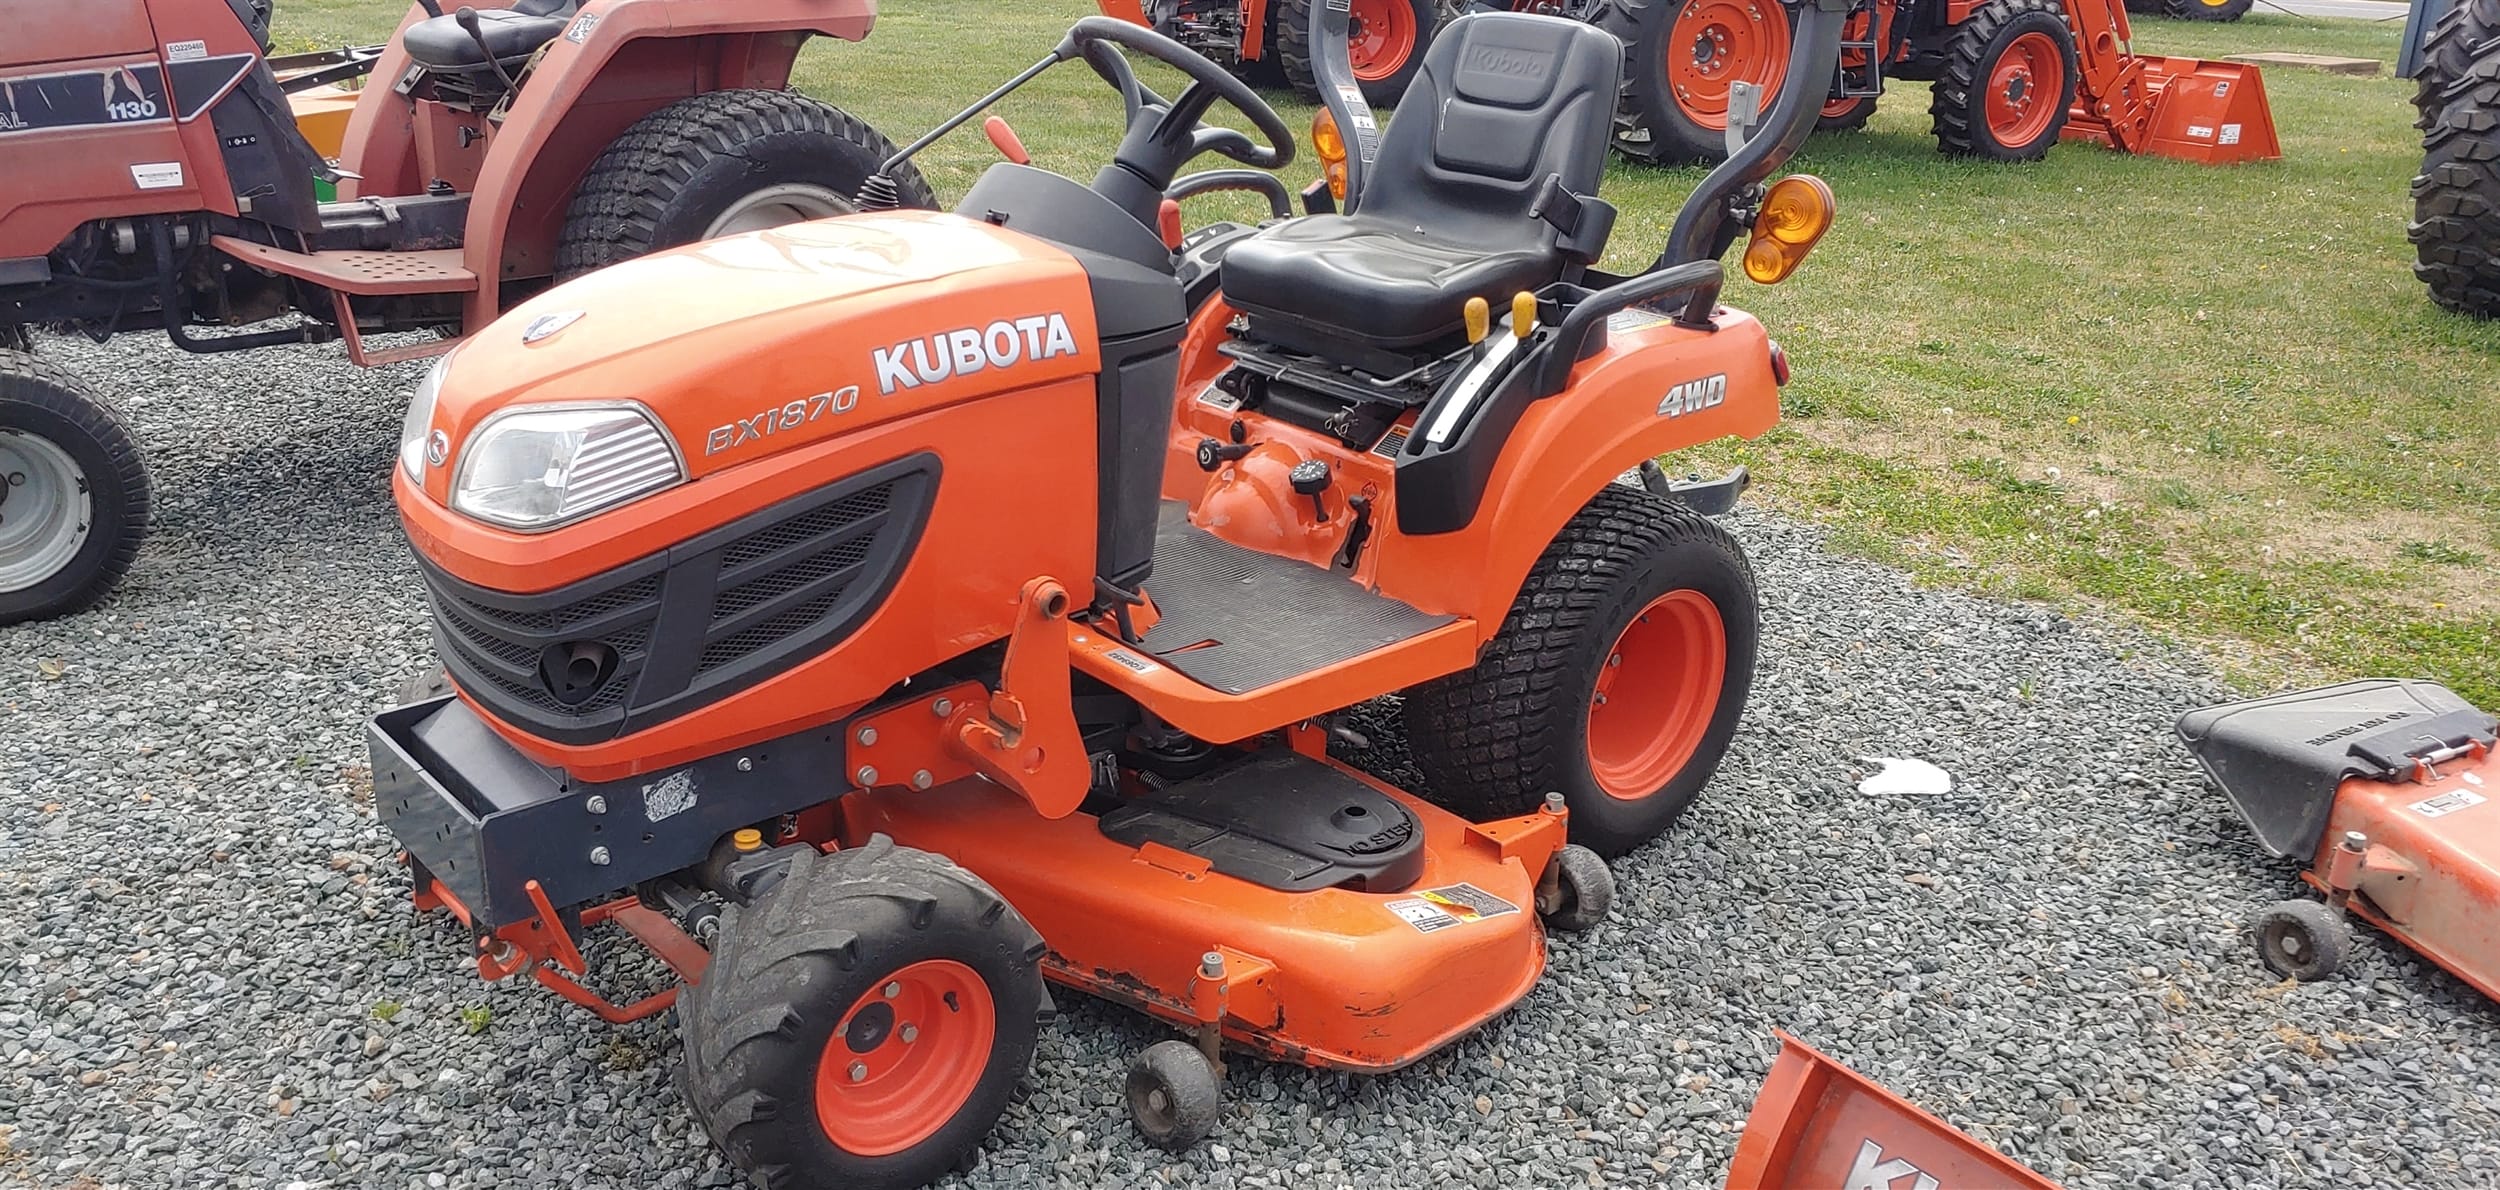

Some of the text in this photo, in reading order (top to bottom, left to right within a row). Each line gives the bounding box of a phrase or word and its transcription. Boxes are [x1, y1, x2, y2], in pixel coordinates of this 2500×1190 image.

[106, 100, 157, 120] 1130
[873, 312, 1079, 395] KUBOTA
[1656, 373, 1727, 418] 4WD
[705, 385, 860, 456] BX1870
[1344, 841, 1369, 858] NO
